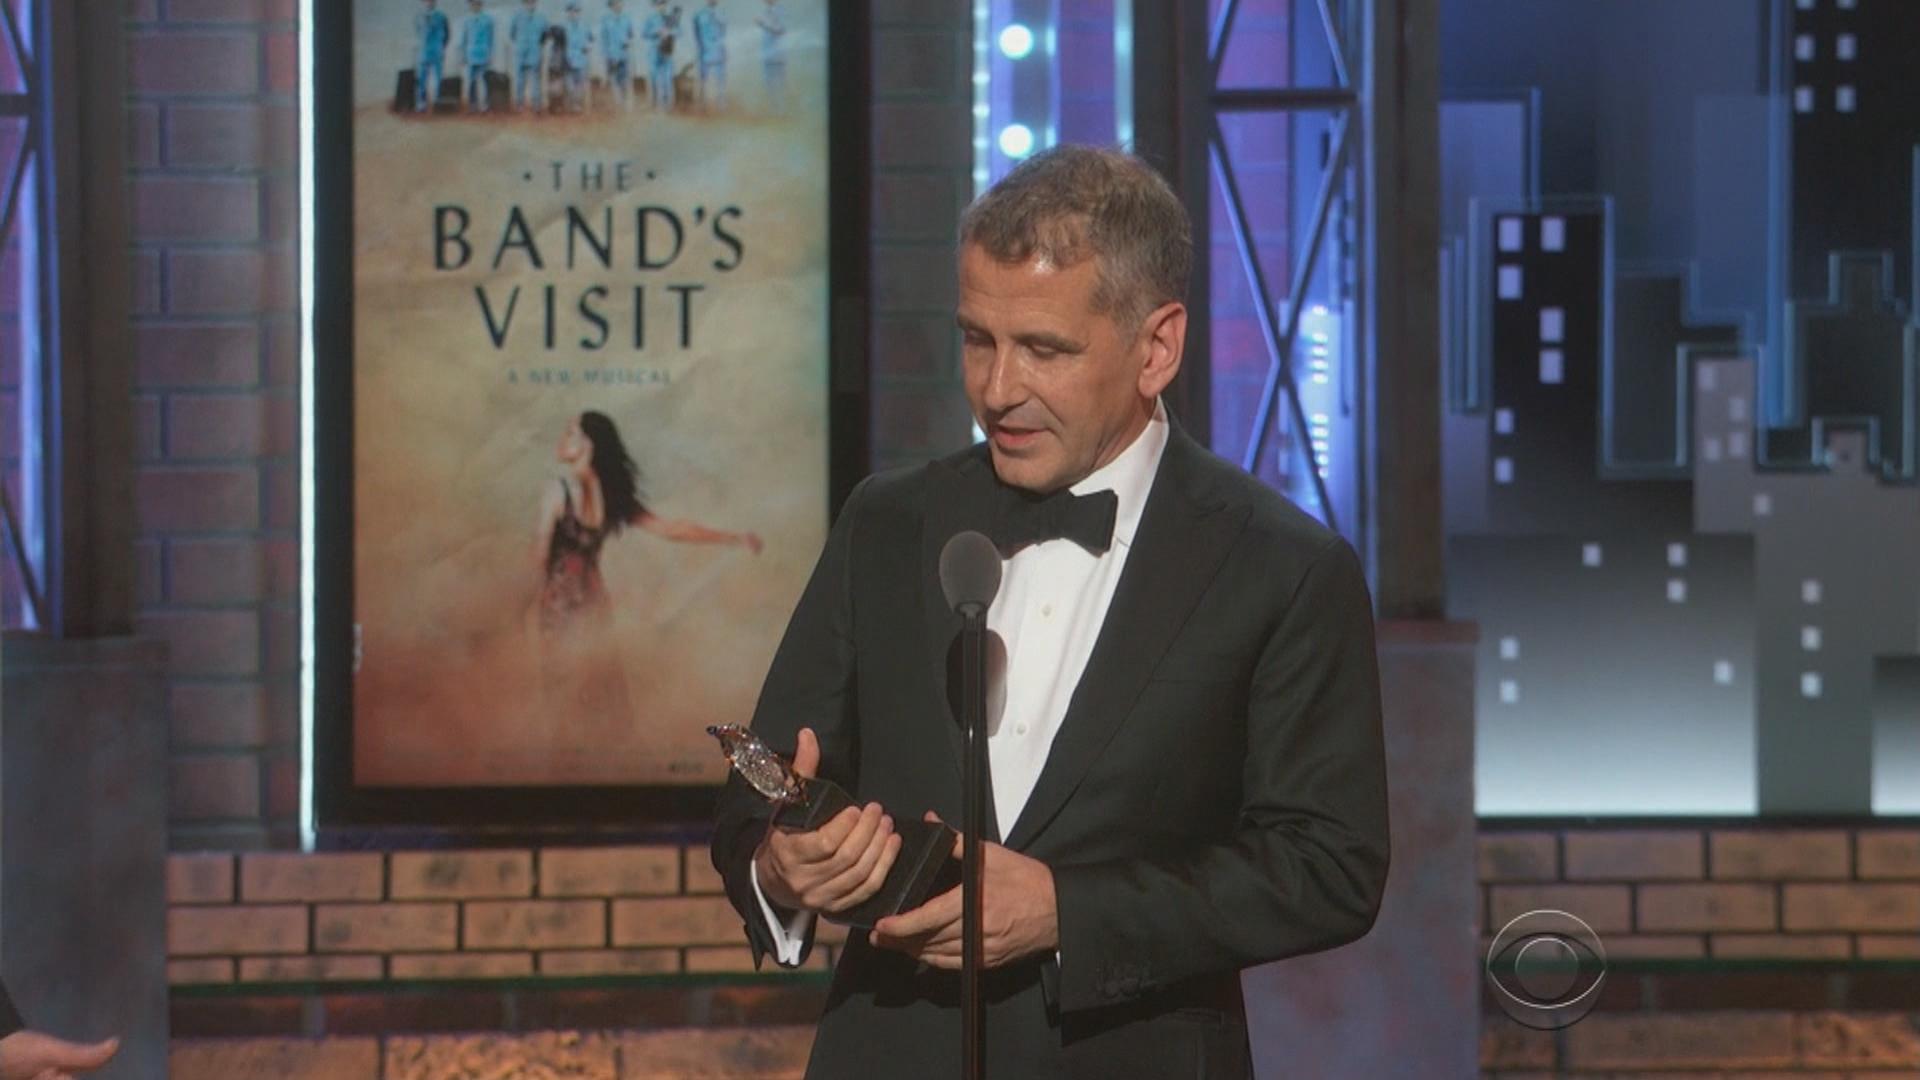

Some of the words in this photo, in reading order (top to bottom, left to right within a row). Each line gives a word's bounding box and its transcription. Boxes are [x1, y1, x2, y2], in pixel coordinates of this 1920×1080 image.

[434, 205, 744, 271] BAND'S
[474, 284, 705, 349] VISIT
[508, 369, 519, 385] A
[529, 369, 571, 385] NEW
[583, 369, 673, 385] MUSICAL
